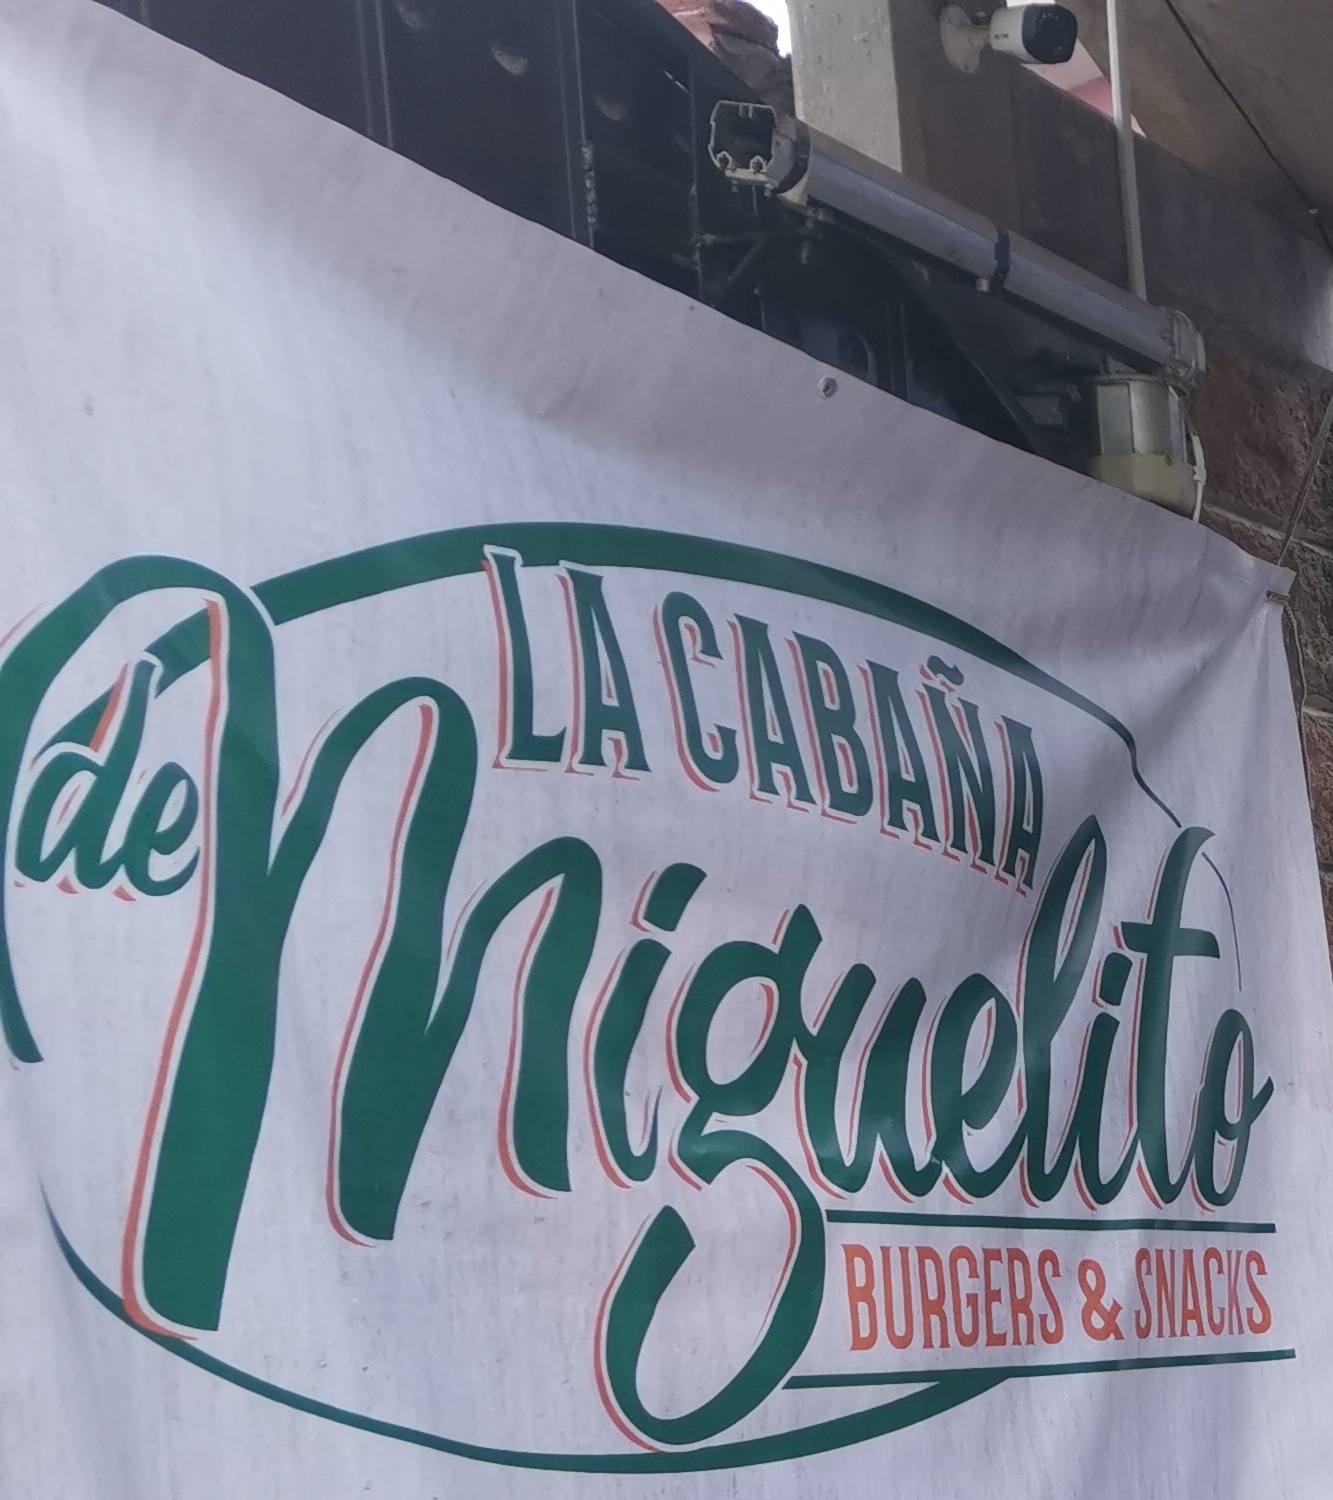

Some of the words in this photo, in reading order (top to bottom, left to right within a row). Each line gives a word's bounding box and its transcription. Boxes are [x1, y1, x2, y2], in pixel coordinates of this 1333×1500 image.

[12, 651, 202, 901] de
[483, 544, 650, 776] LA
[660, 591, 1043, 893] CABAÑA
[0, 555, 1274, 1452] Miguelito
[844, 1247, 1064, 1352] BURGERS
[1076, 1261, 1125, 1343] &
[1132, 1249, 1273, 1337] SNACKS
